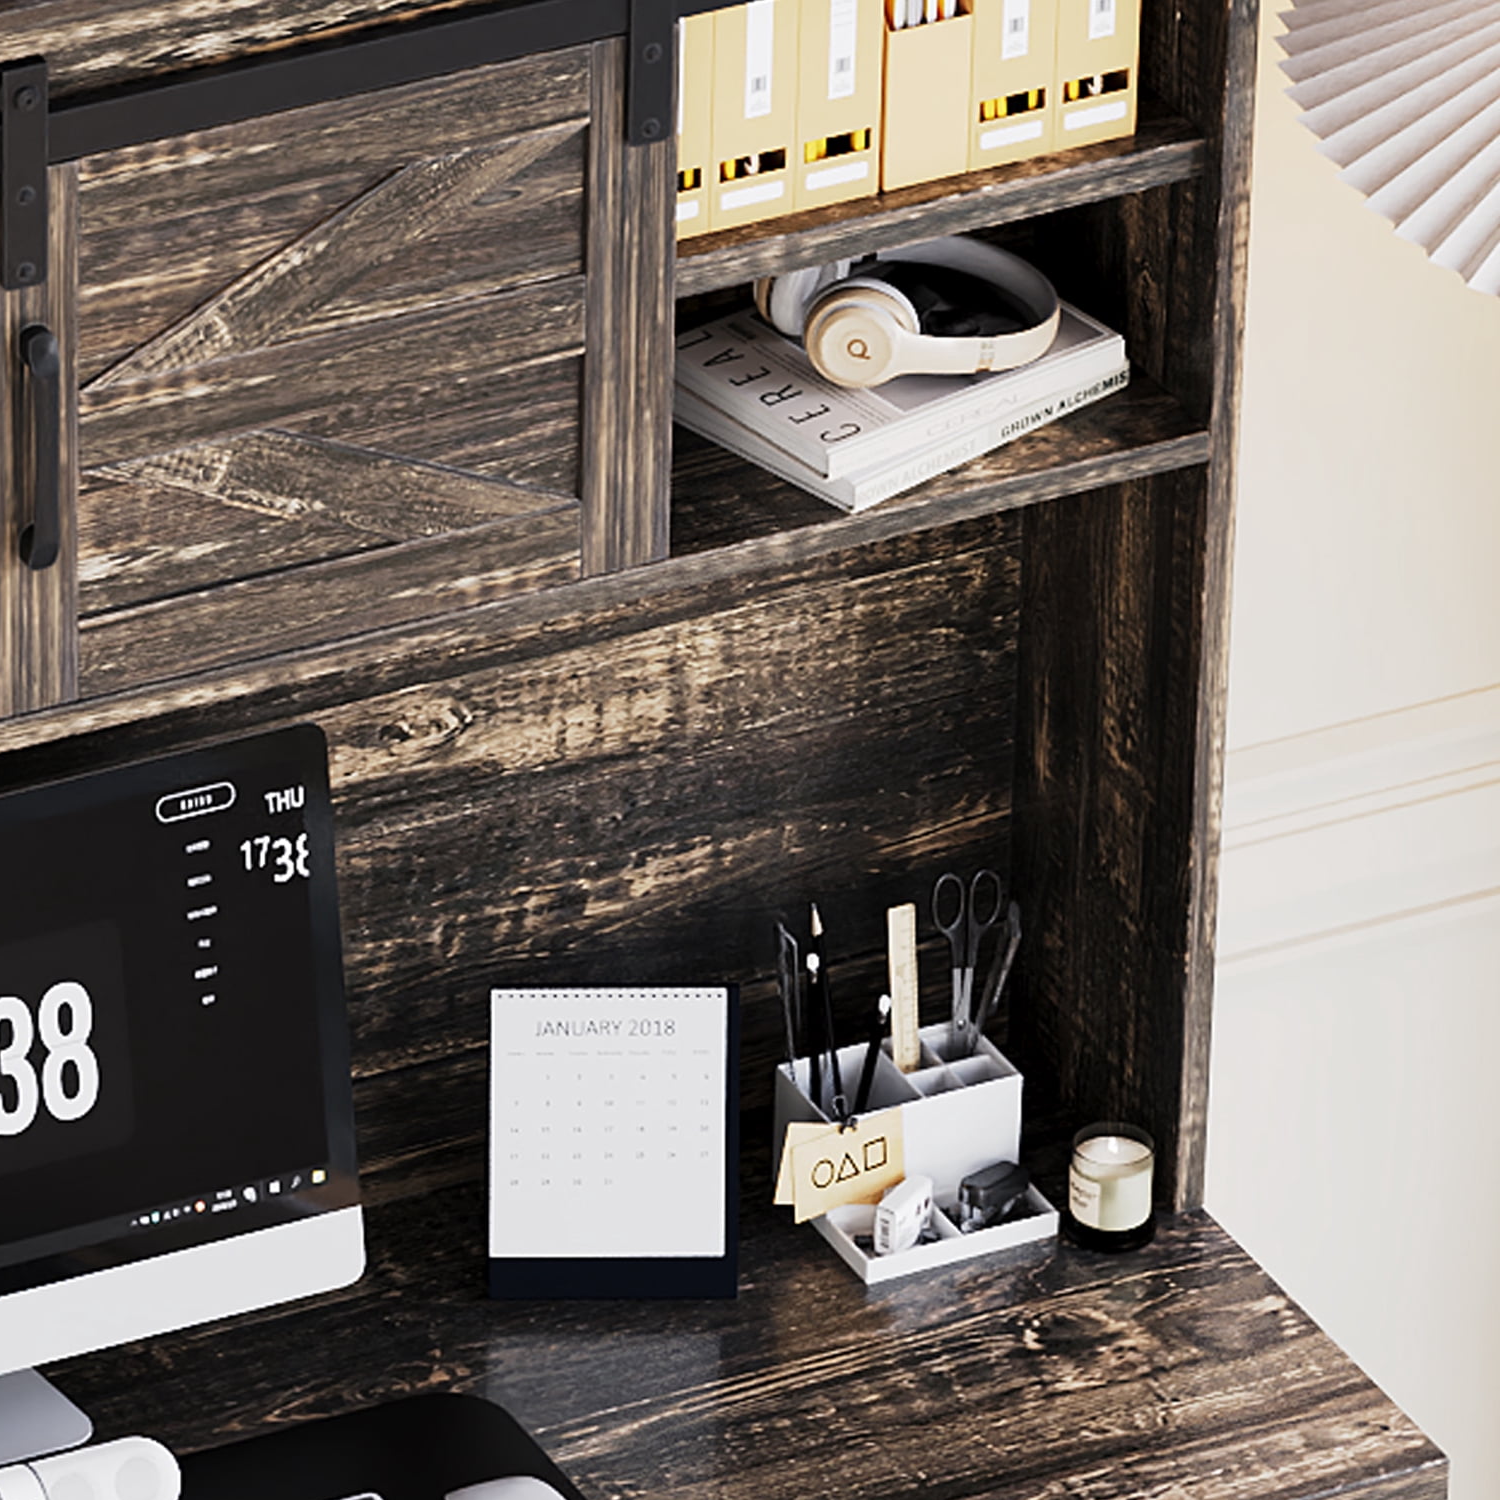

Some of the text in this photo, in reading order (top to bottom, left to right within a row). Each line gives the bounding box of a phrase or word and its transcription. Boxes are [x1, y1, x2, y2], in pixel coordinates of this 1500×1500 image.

[1056, 368, 1130, 414] ALCHEMIS
[535, 1018, 677, 1038] JANUARY 2018
